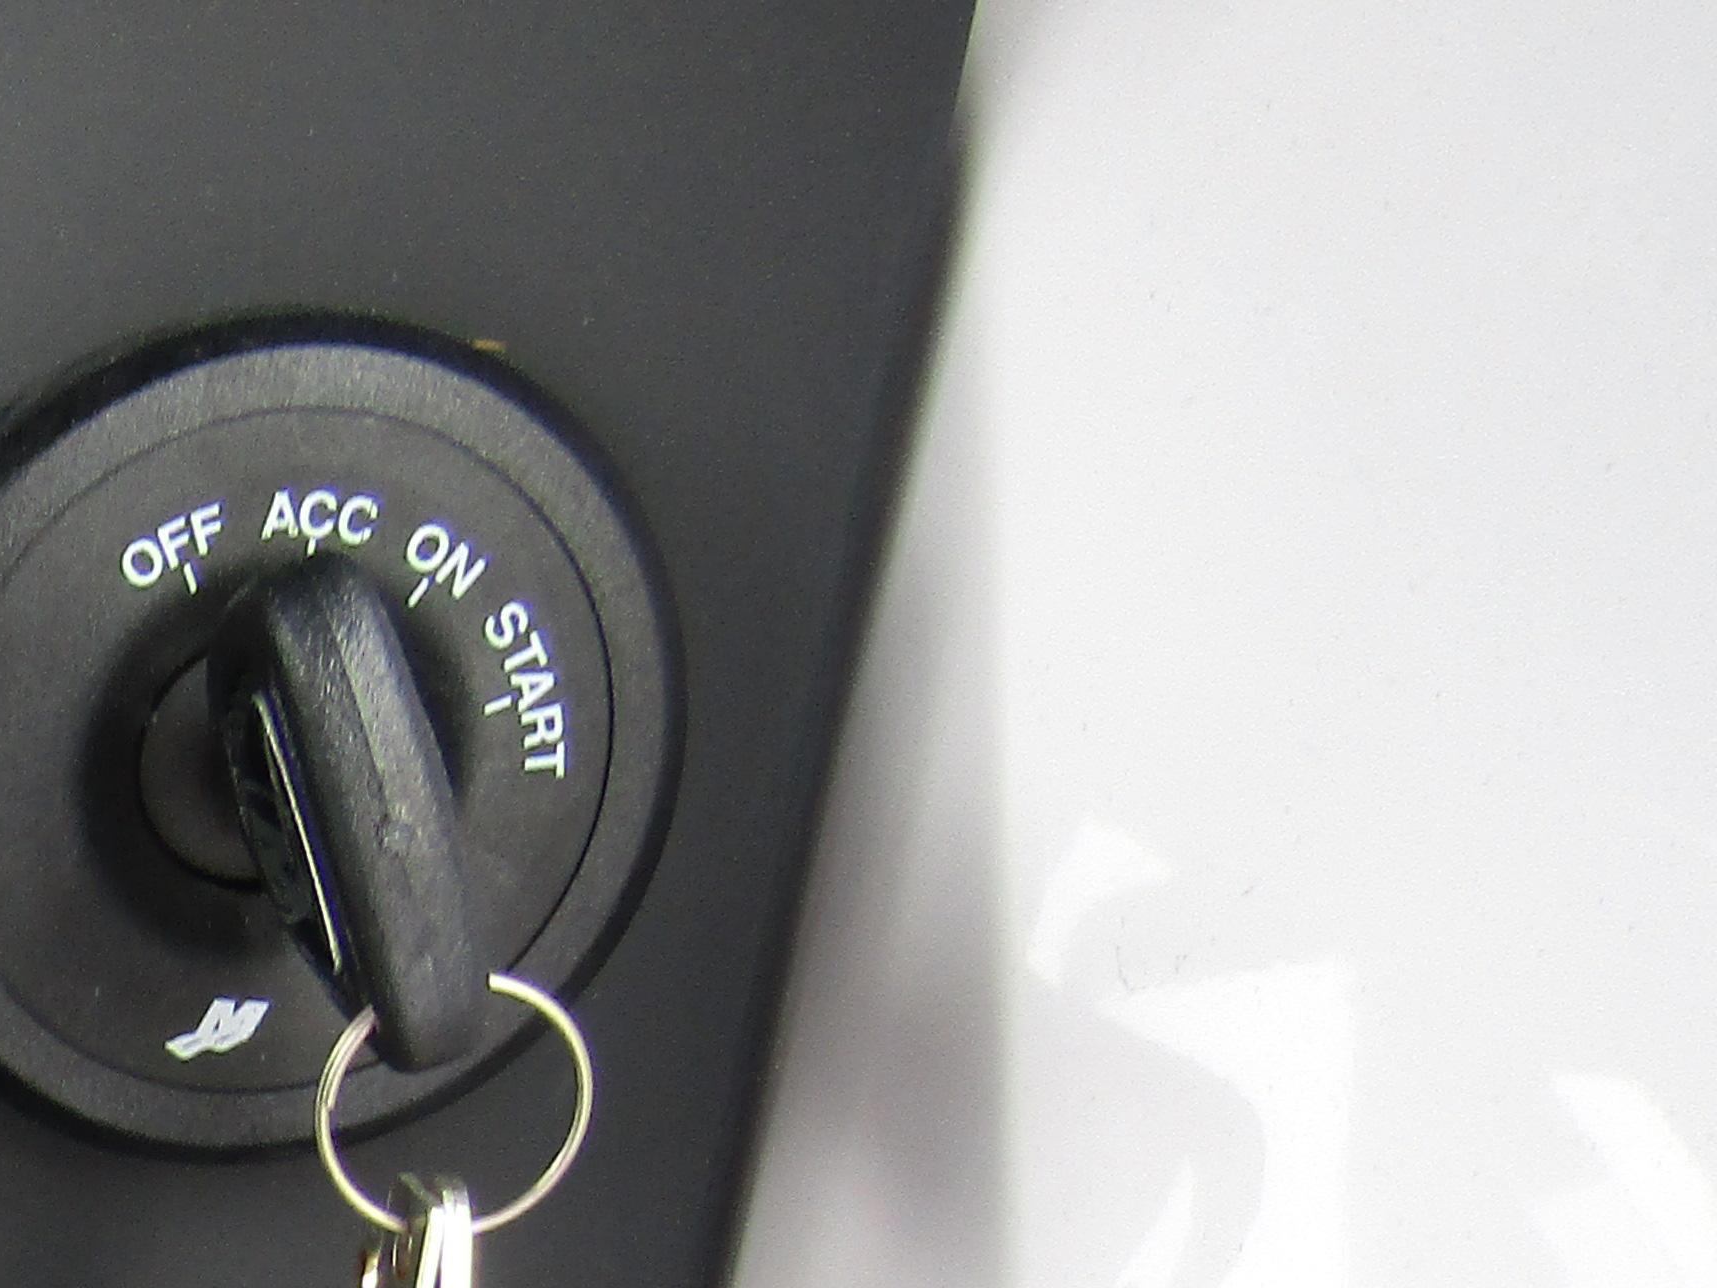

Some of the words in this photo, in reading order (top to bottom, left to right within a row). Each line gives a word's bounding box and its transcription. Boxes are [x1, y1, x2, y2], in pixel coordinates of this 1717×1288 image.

[120, 503, 221, 588] OFF
[261, 489, 379, 548] ACC
[405, 522, 487, 600] ON
[484, 600, 566, 780] START
